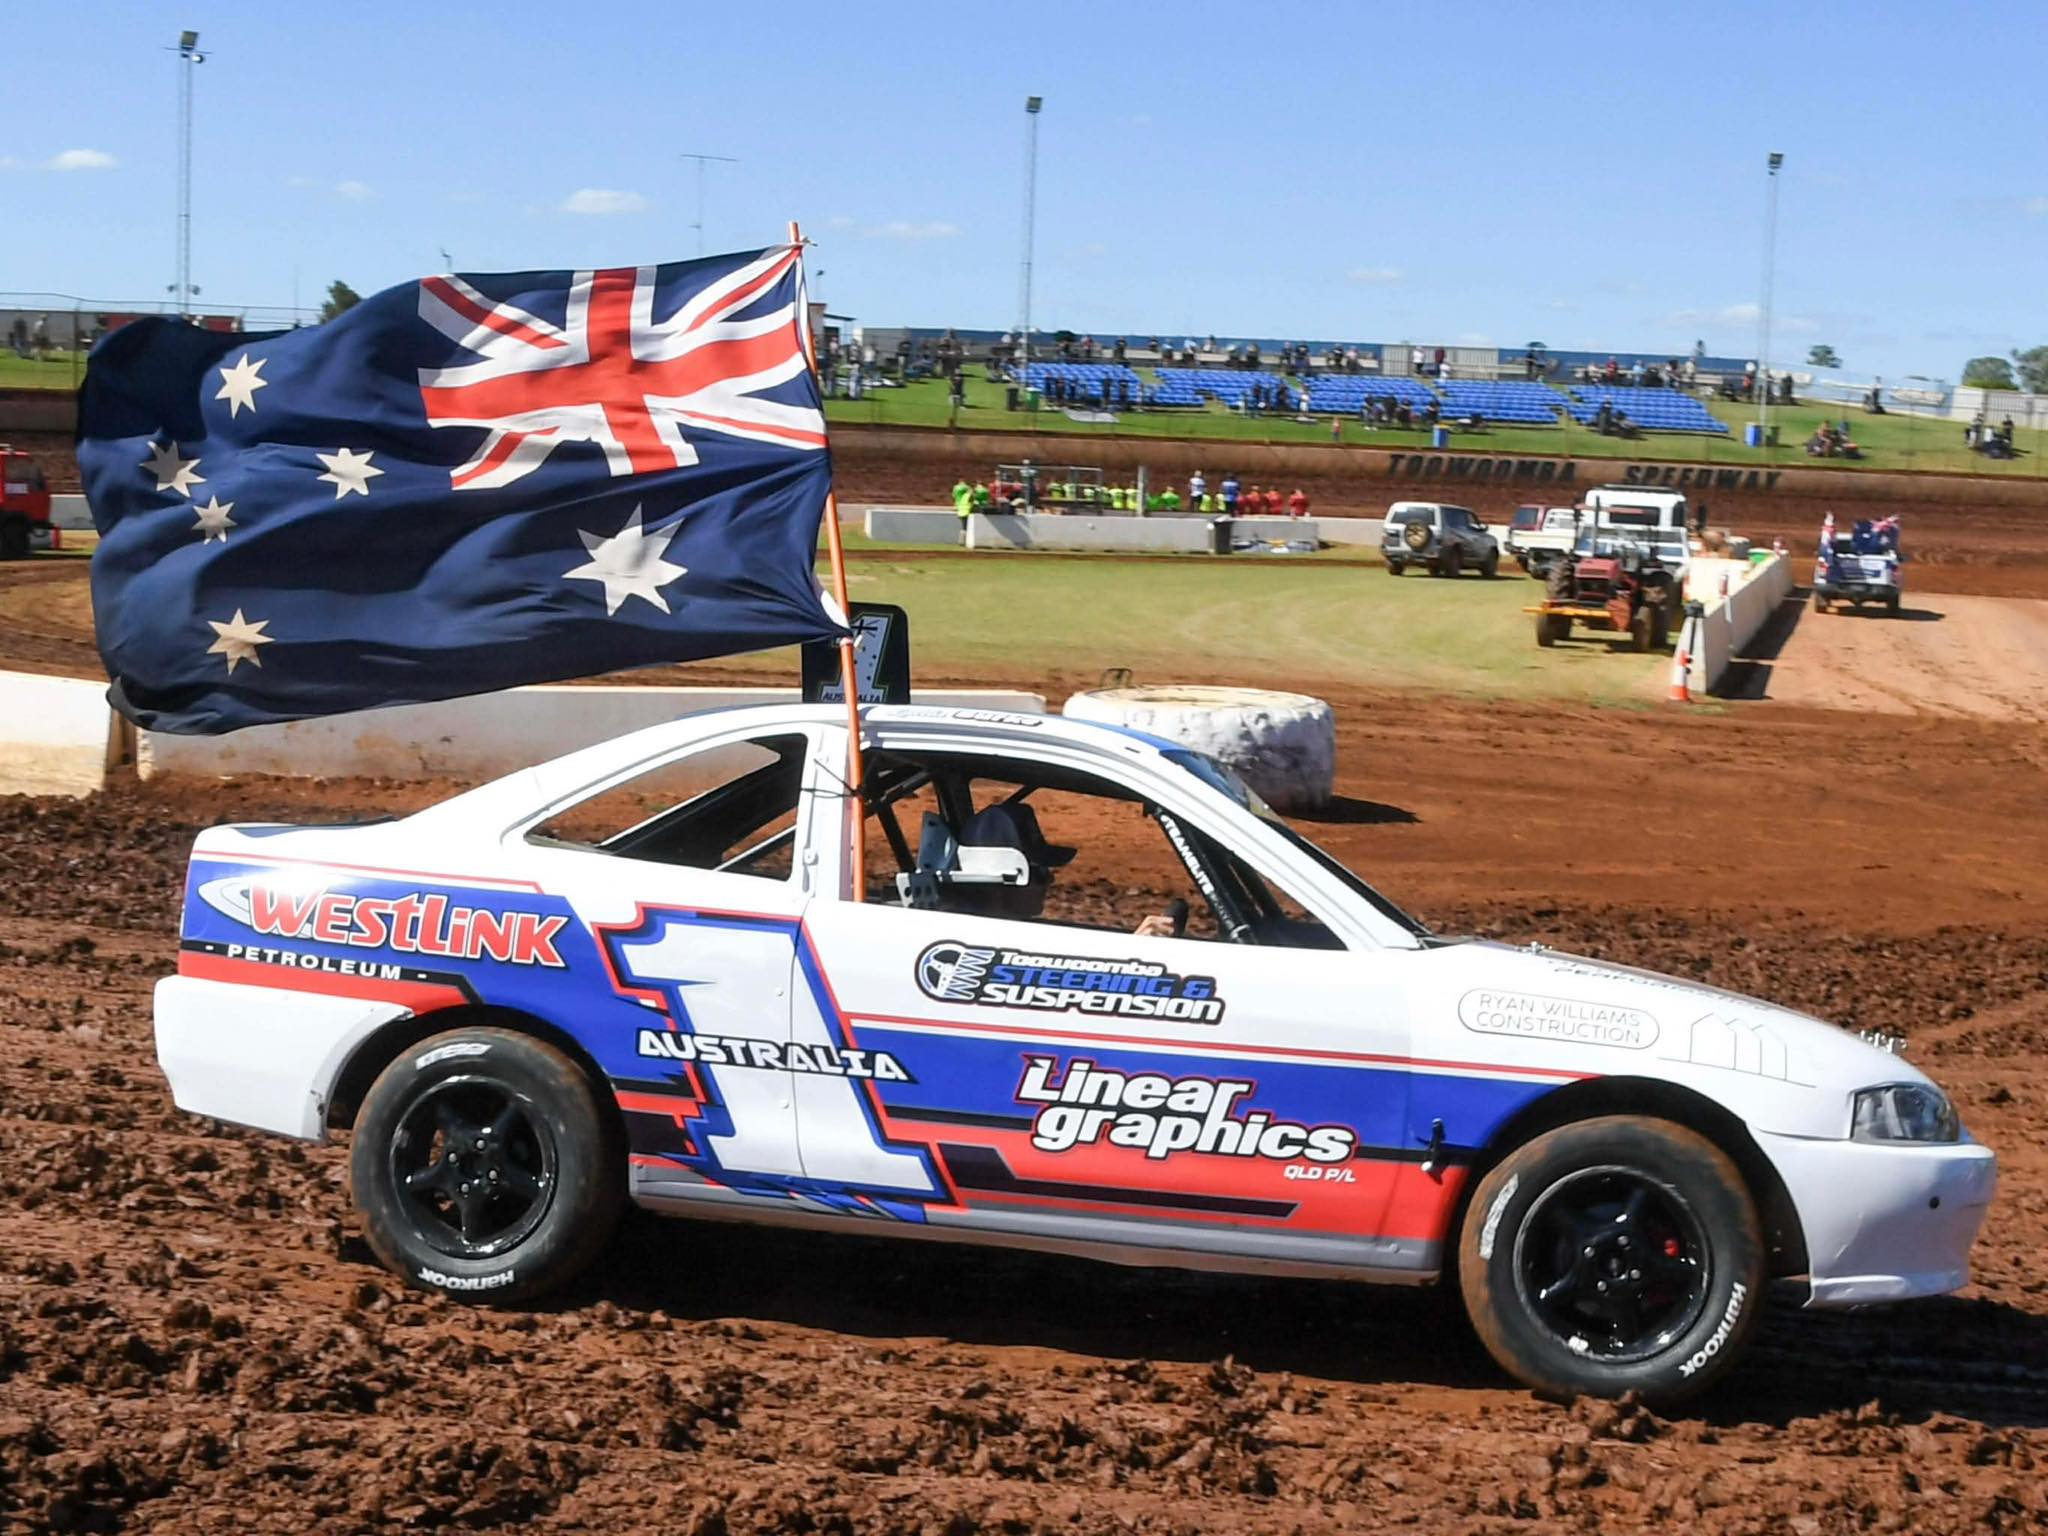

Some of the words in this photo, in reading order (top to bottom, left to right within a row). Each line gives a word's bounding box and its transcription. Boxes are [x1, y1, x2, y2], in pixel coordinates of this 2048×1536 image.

[1388, 453, 1577, 484] TOOWOOMBA
[1623, 465, 1783, 491] SPEEDWAY
[227, 943, 402, 981] PETROLEUM
[990, 964, 1175, 996] STEERING
[1181, 979, 1211, 998] &
[999, 951, 1164, 977] Toowoomba
[979, 982, 1222, 1022] SUSPENSION
[1478, 992, 1535, 1013] RYAN
[1543, 1001, 1641, 1028] WILLIAMS
[1475, 1010, 1641, 1044] CONSTRUCTION
[638, 1029, 910, 1082] AUSTRALIA
[1018, 1056, 1251, 1114] Linear
[1031, 1106, 1355, 1161] graphics
[1283, 1164, 1323, 1181] QLD
[1323, 1167, 1356, 1183] P/L
